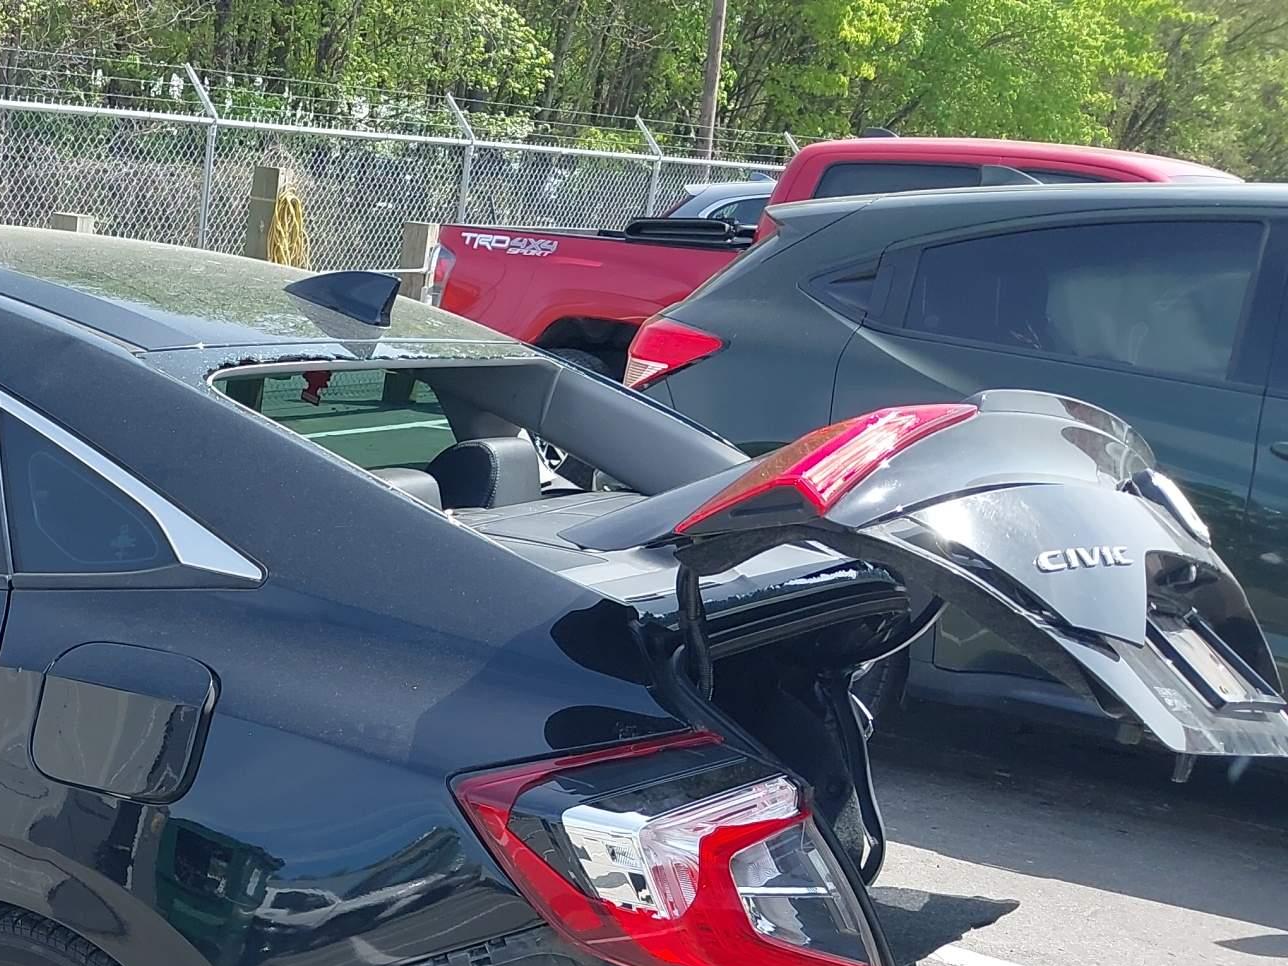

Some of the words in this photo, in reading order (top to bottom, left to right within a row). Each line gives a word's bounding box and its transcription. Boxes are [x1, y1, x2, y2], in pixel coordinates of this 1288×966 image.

[461, 231, 511, 251] TRD
[506, 247, 553, 257] SPORT
[1037, 546, 1134, 573] CIVIC
